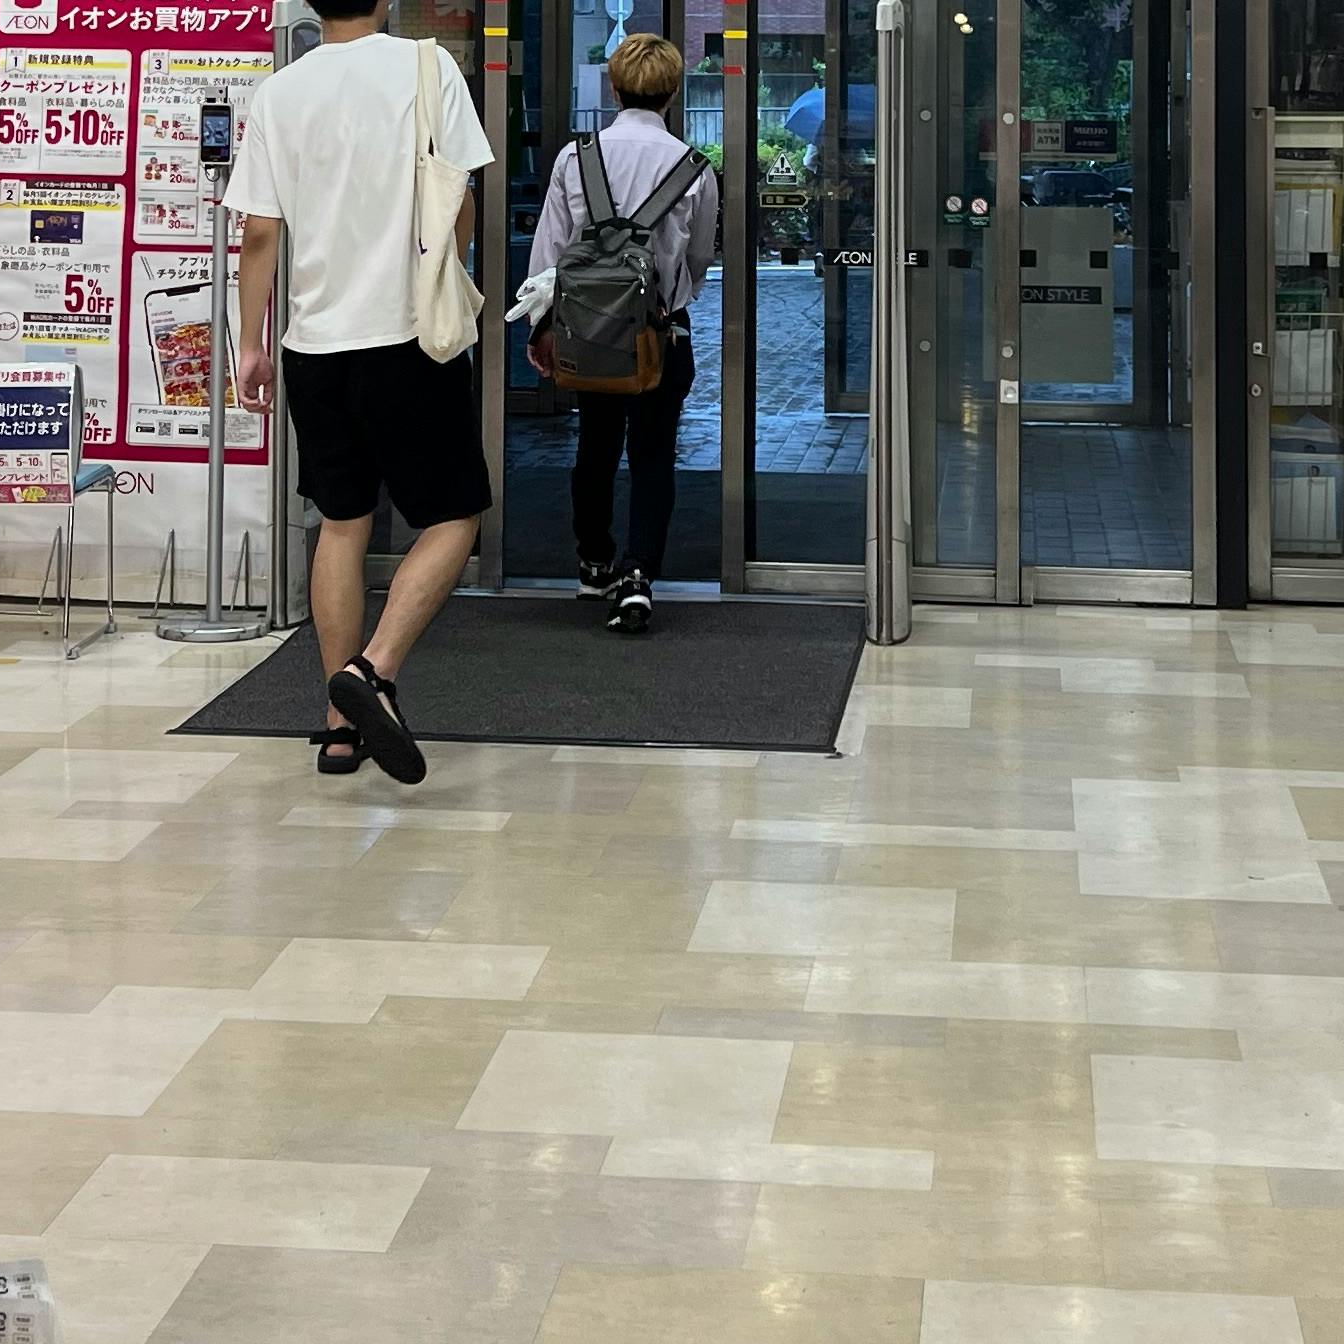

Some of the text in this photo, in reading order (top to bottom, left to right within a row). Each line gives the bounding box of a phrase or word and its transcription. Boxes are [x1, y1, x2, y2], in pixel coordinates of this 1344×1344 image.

[6, 15, 50, 30] AEON
[59, 7, 274, 33] イオンお買物アプリ
[0, 79, 126, 96] クーポンプレゼント!
[1047, 288, 1090, 302] STYLE
